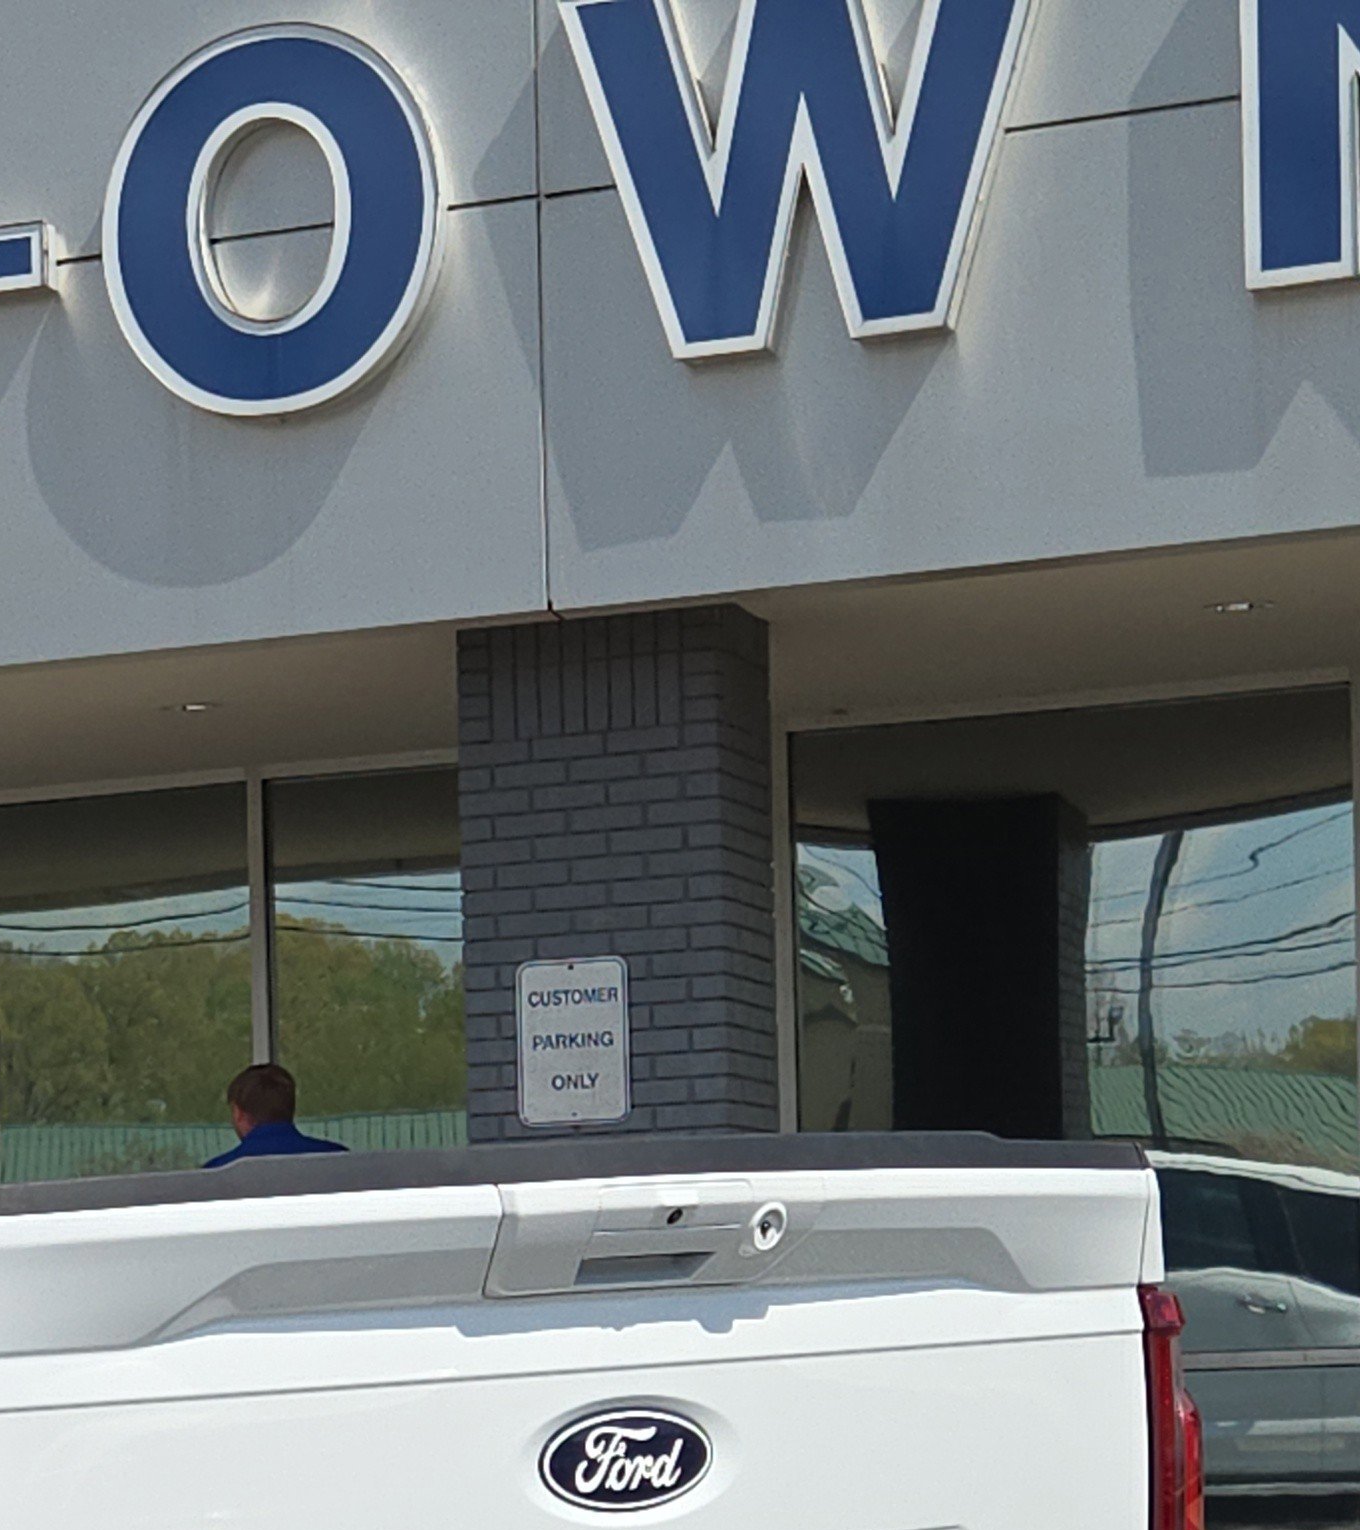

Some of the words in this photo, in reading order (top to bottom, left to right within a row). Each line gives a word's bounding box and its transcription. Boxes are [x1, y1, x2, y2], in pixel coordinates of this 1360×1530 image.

[527, 987, 619, 1008] CUSTOMER
[532, 1031, 615, 1050] PARKING
[551, 1072, 600, 1091] ONLY
[574, 1425, 684, 1494] Ford
